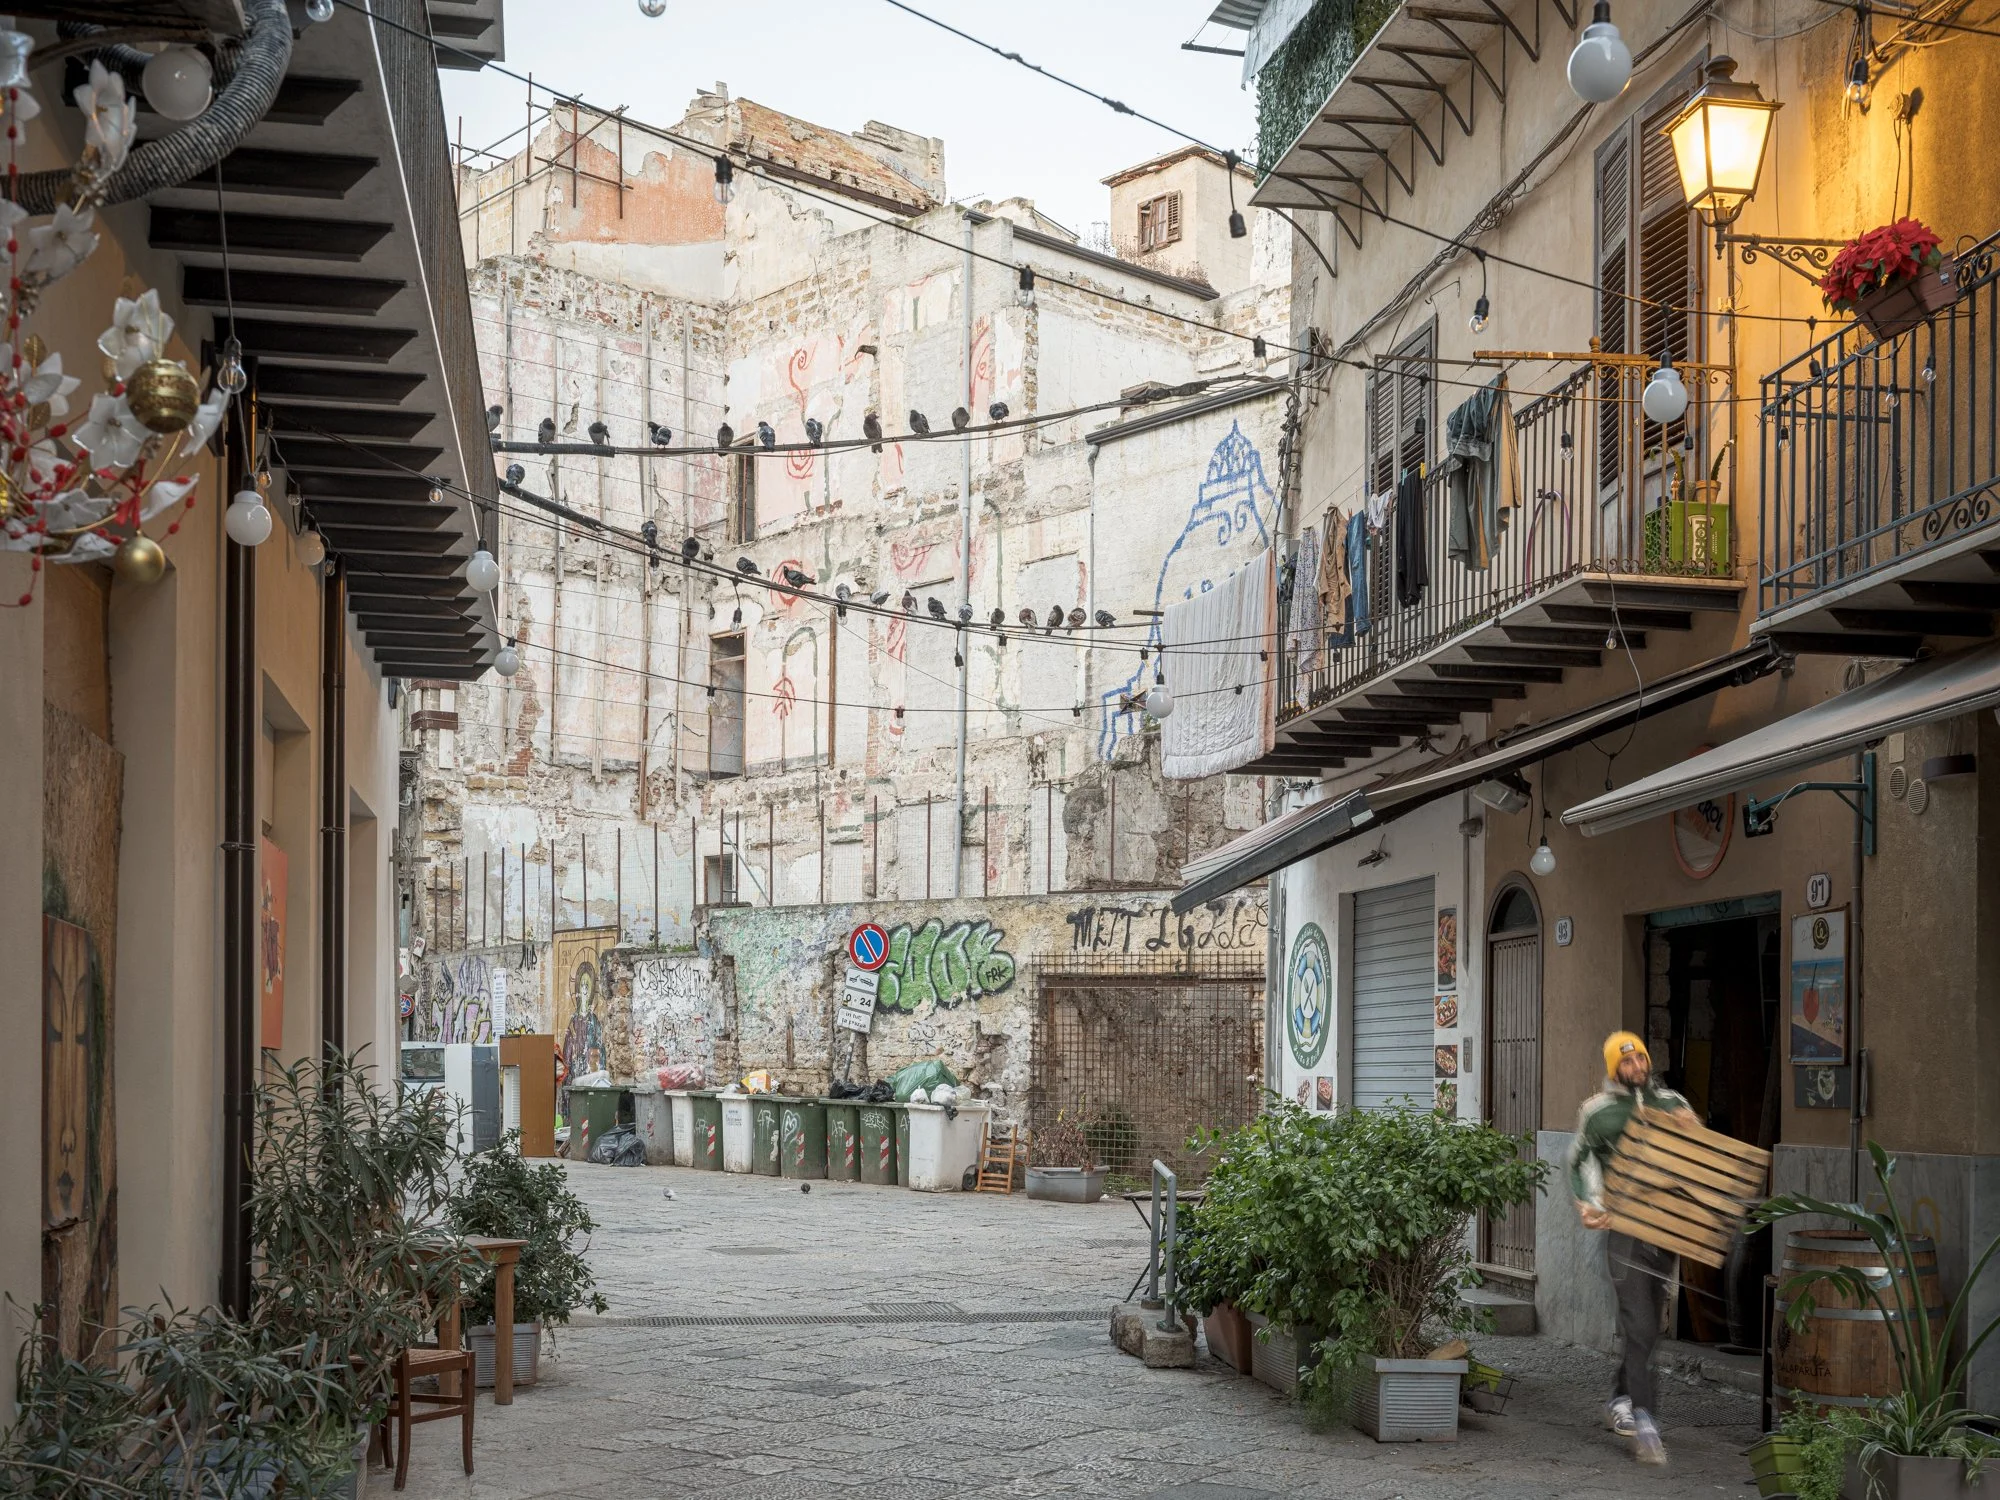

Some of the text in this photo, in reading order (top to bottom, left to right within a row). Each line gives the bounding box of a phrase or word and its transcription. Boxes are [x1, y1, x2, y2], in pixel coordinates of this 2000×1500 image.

[1811, 878, 1825, 903] 91
[1558, 921, 1568, 941] 93
[860, 998, 871, 1007] 24
